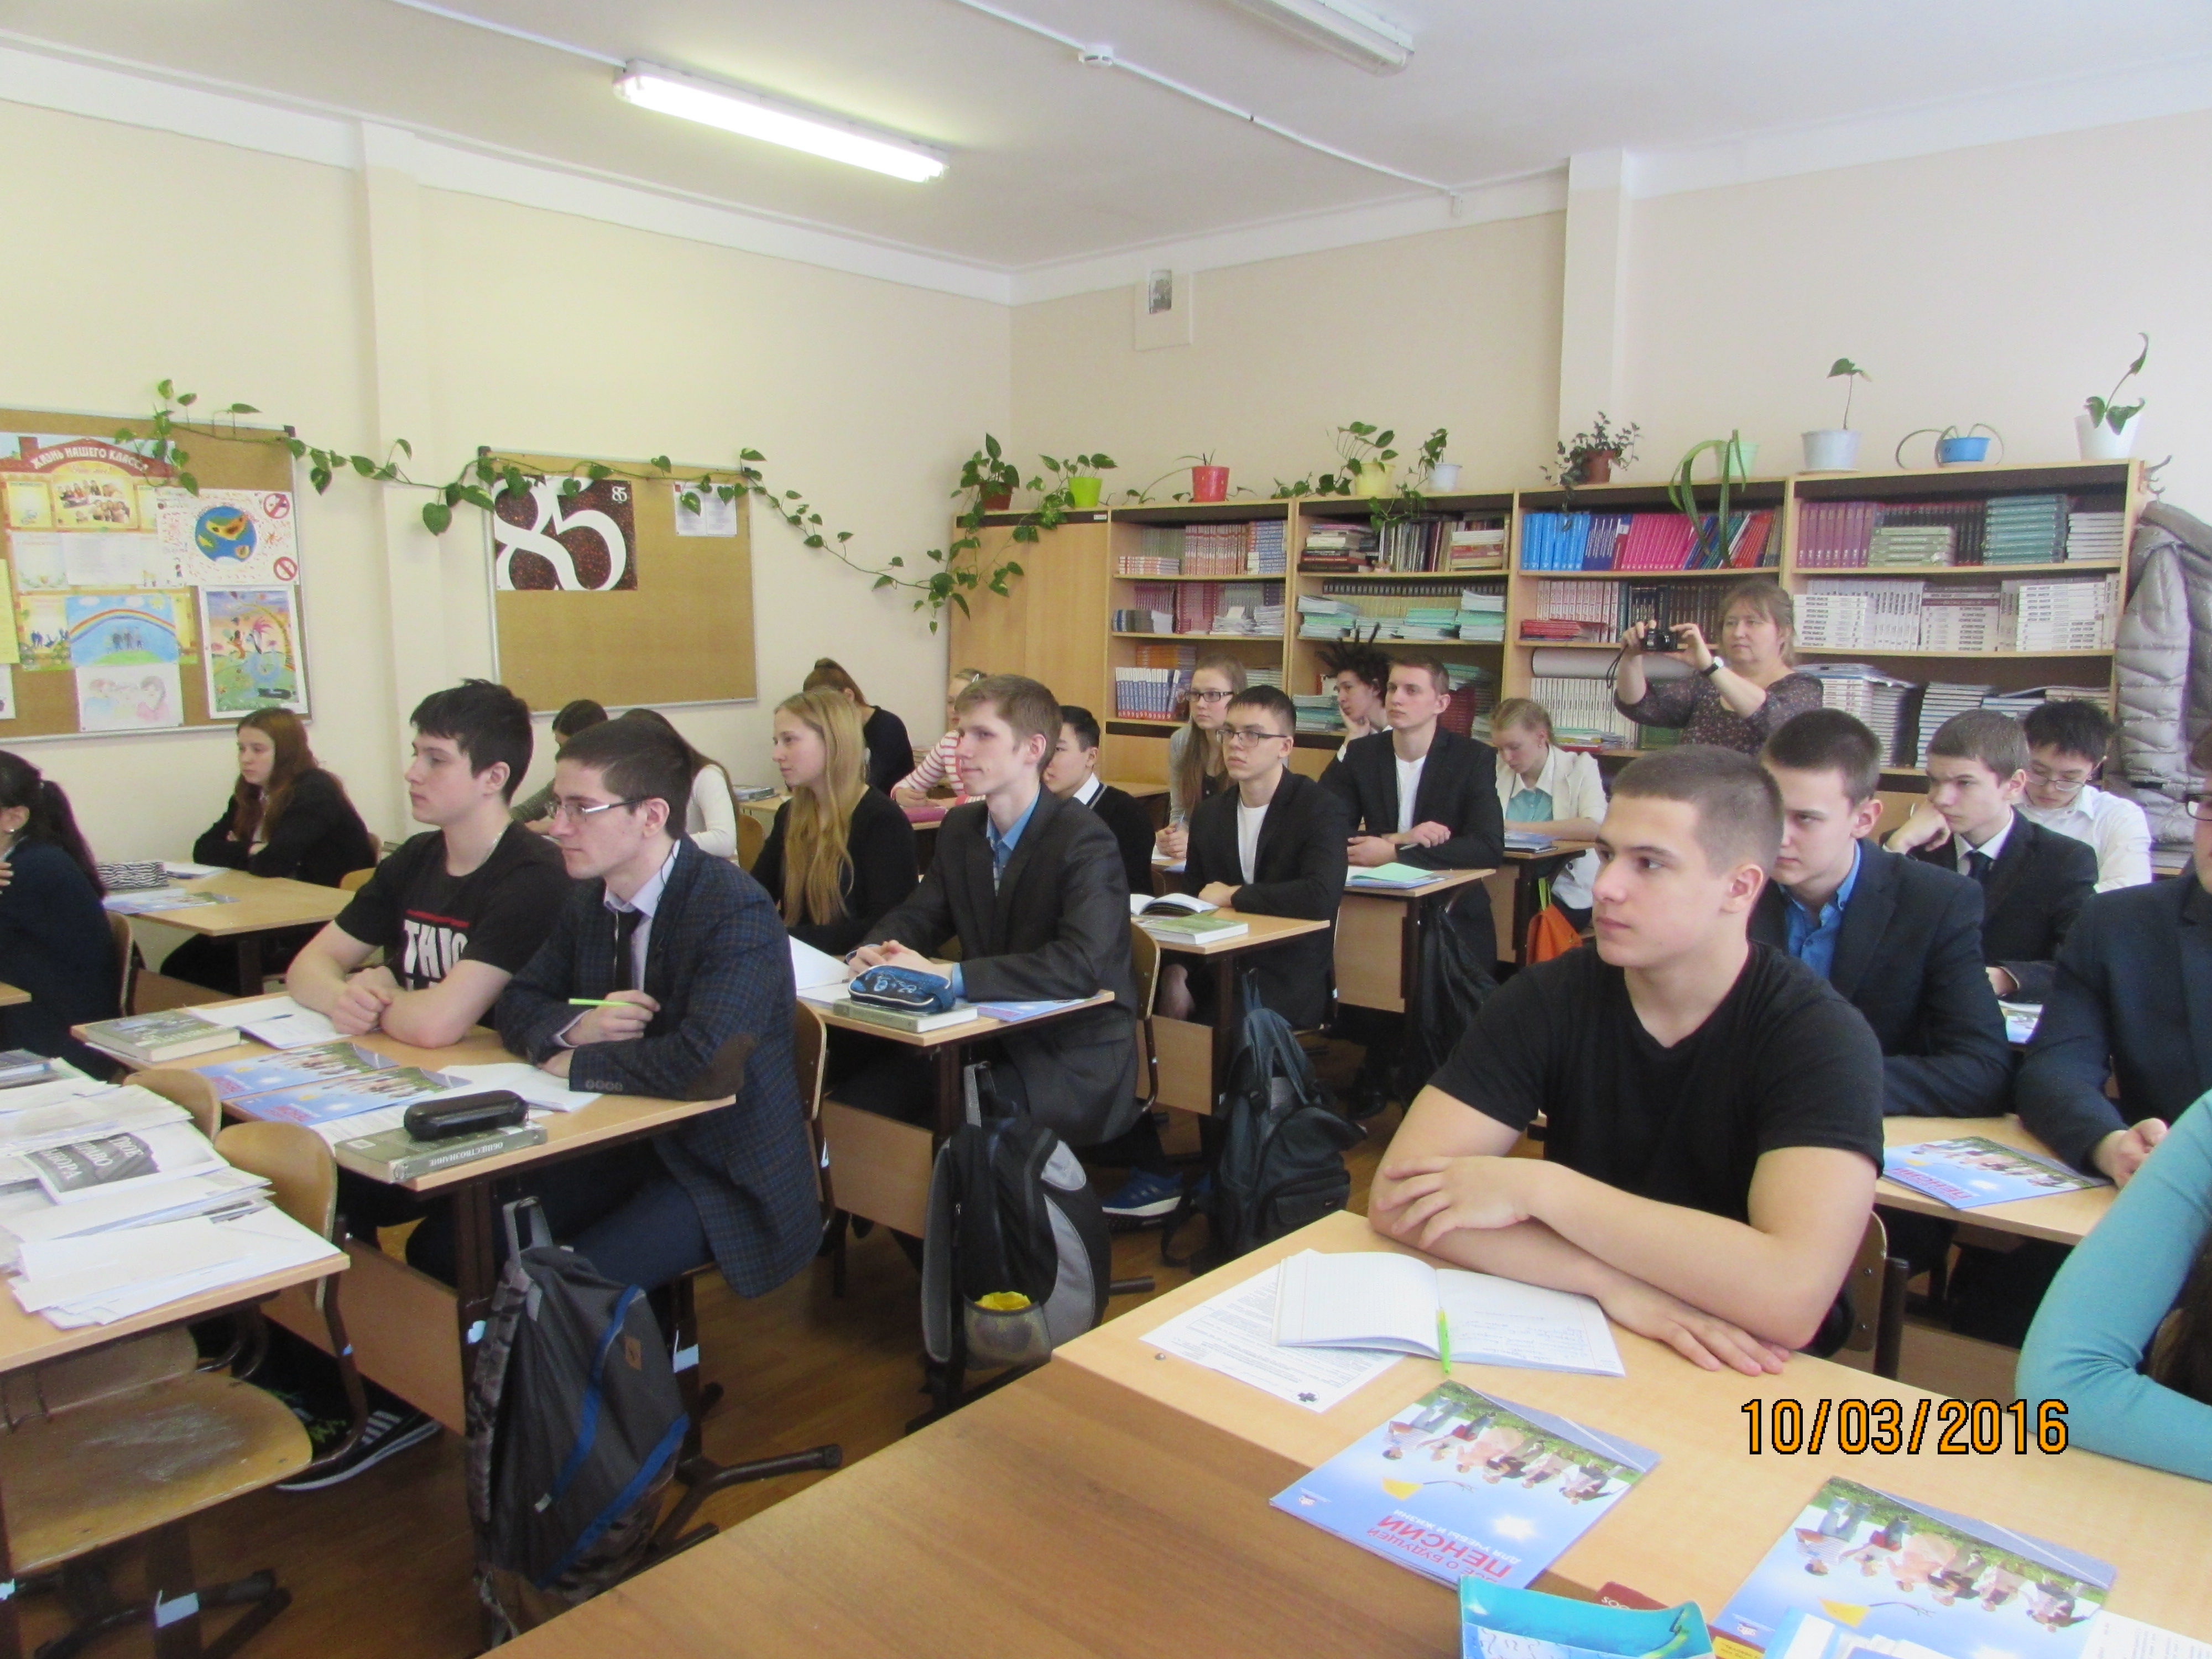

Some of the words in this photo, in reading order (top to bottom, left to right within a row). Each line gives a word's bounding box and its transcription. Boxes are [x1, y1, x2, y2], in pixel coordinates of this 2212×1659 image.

[30, 449, 64, 469] ЖИЗНЬ
[64, 446, 107, 458] НАШЕГО
[612, 486, 627, 502] 85
[71, 1141, 113, 1166] ПРАВО
[429, 1141, 504, 1167] ОБЩЕСТВОЗНАНИЕ
[1393, 1509, 1436, 1530] ЖИЗНИ
[1436, 1526, 1447, 1534] И
[1366, 1527, 1445, 1564] БУДУЩЕЙ
[1377, 1515, 1512, 1578] ПЕНСИИ
[1447, 1531, 1492, 1553] УЧЕБЫ
[1446, 1561, 1459, 1570] О
[1493, 1549, 1522, 1564] ДЛЯ
